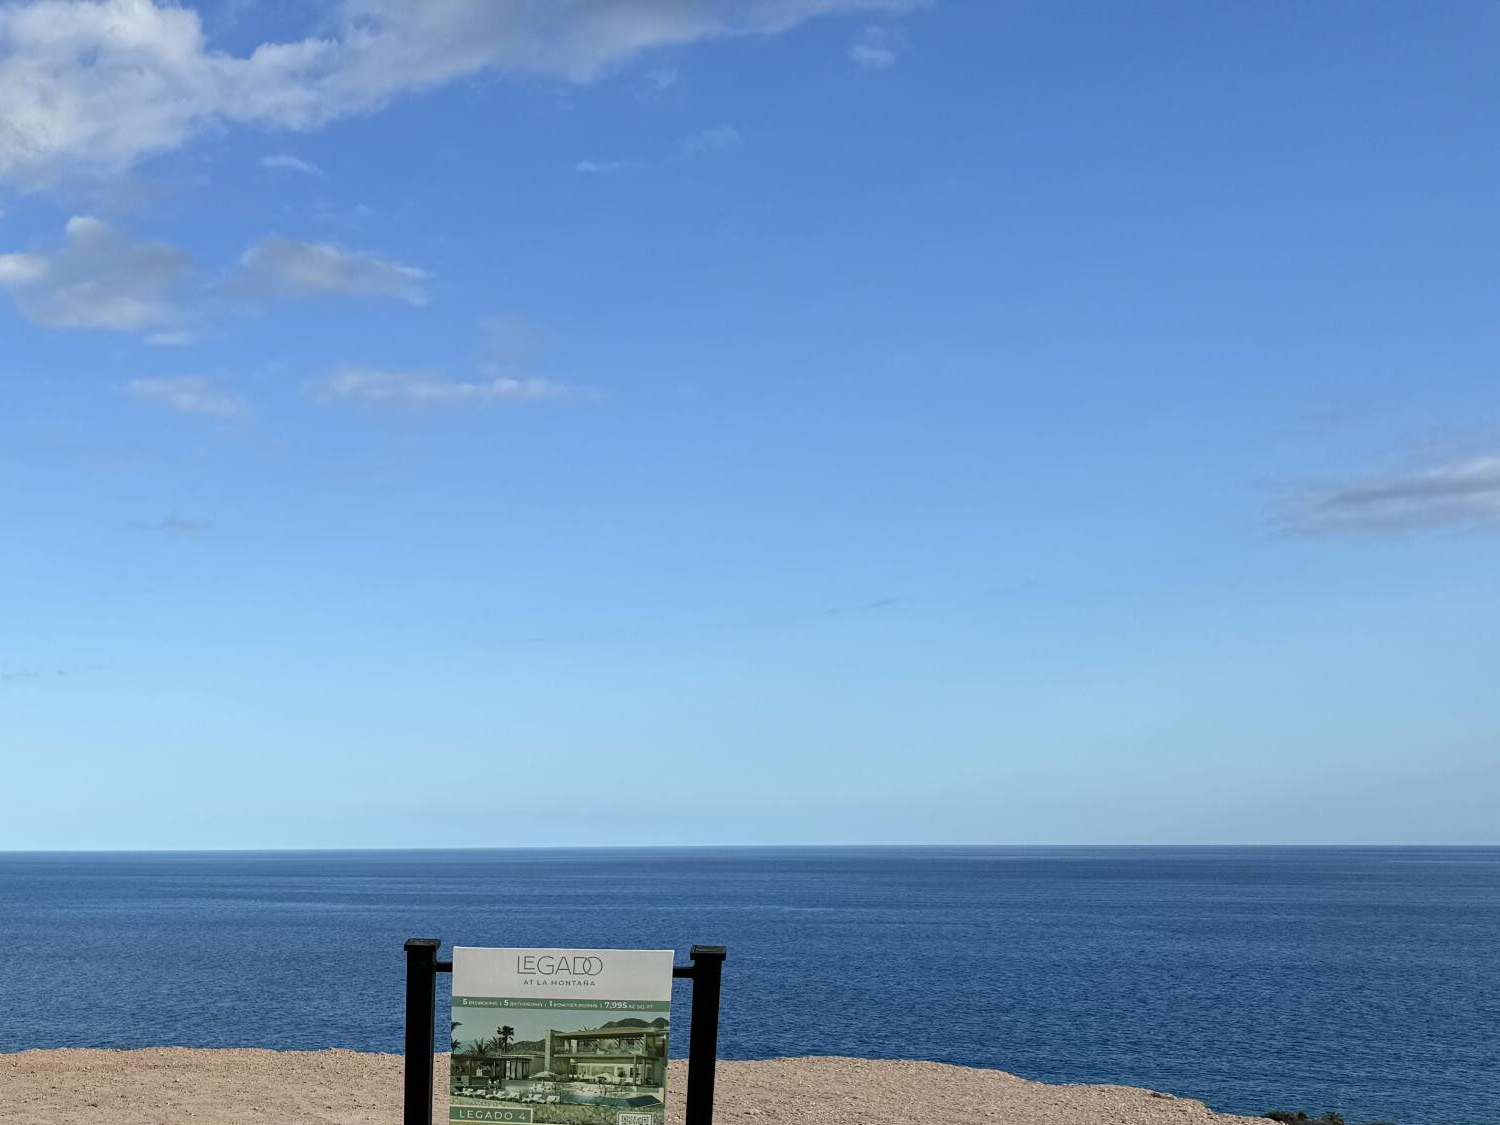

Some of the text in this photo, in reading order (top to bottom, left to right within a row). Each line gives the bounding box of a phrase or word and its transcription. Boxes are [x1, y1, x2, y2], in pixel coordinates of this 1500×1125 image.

[517, 955, 603, 976] LEGADO
[551, 979, 596, 987] MONTAÑA
[503, 999, 509, 1007] 5
[459, 1109, 526, 1121] LEGADO 4
